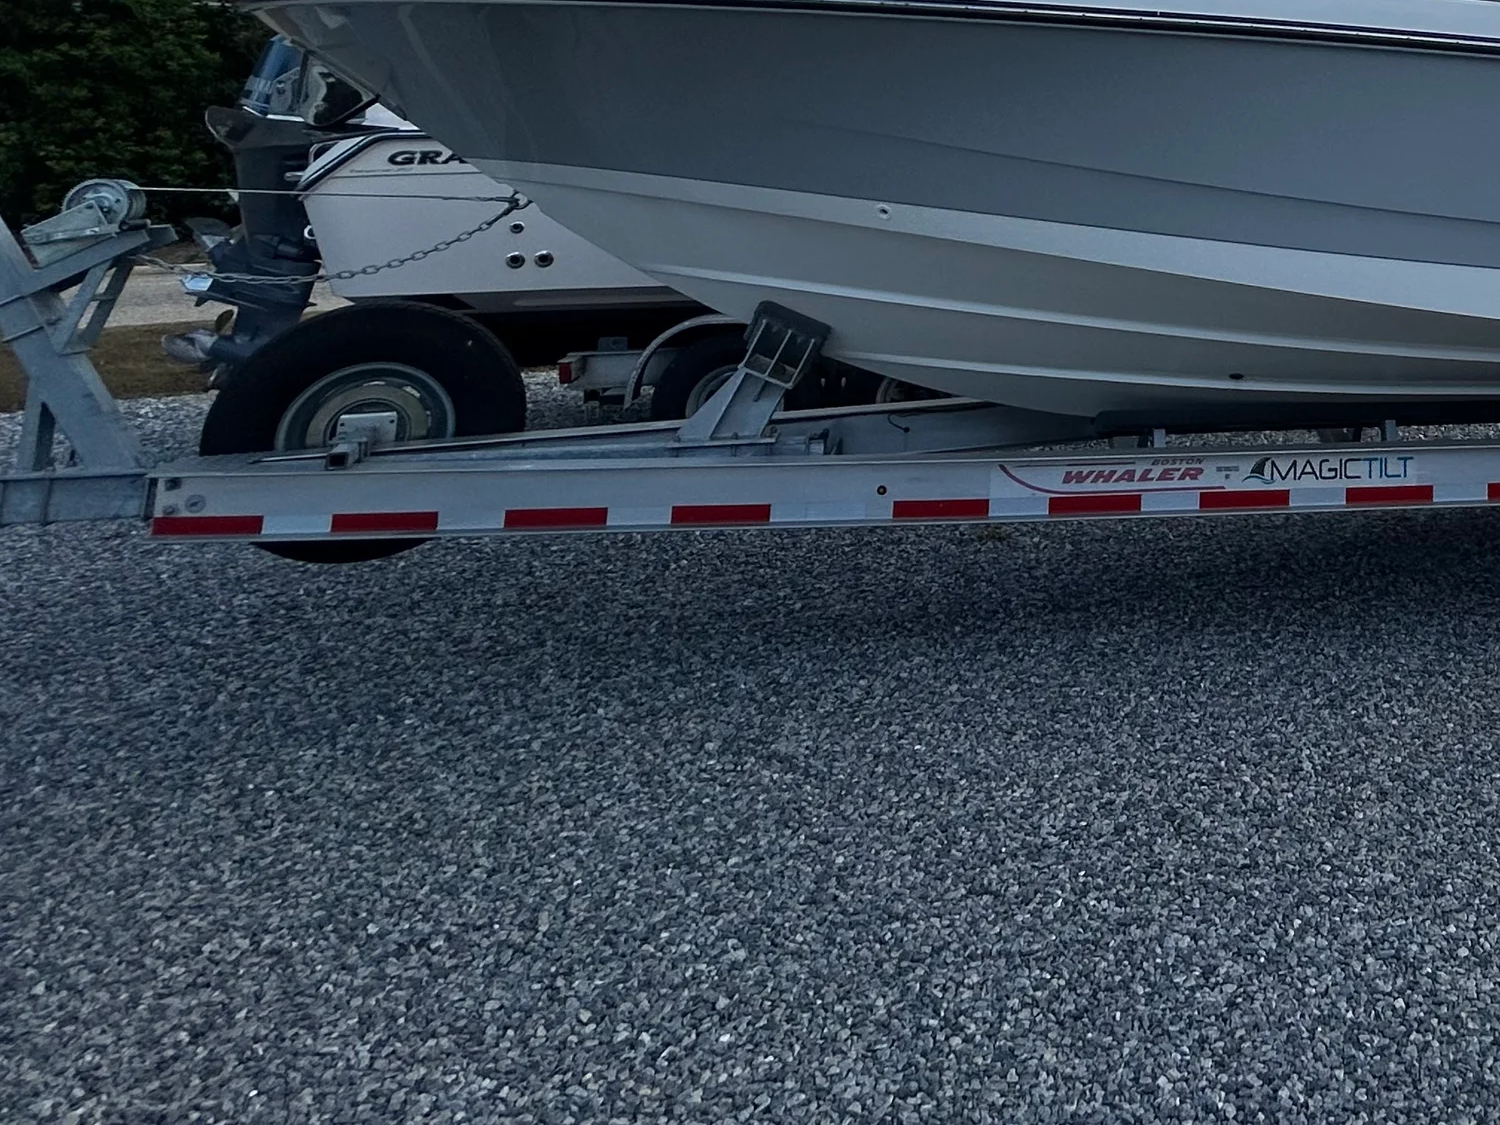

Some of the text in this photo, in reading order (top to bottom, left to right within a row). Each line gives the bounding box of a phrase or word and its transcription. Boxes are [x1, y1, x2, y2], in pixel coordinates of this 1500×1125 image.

[1151, 457, 1206, 466] BOSTON
[1270, 456, 1414, 481] MAGICTILT
[1062, 467, 1204, 484] WHALER
